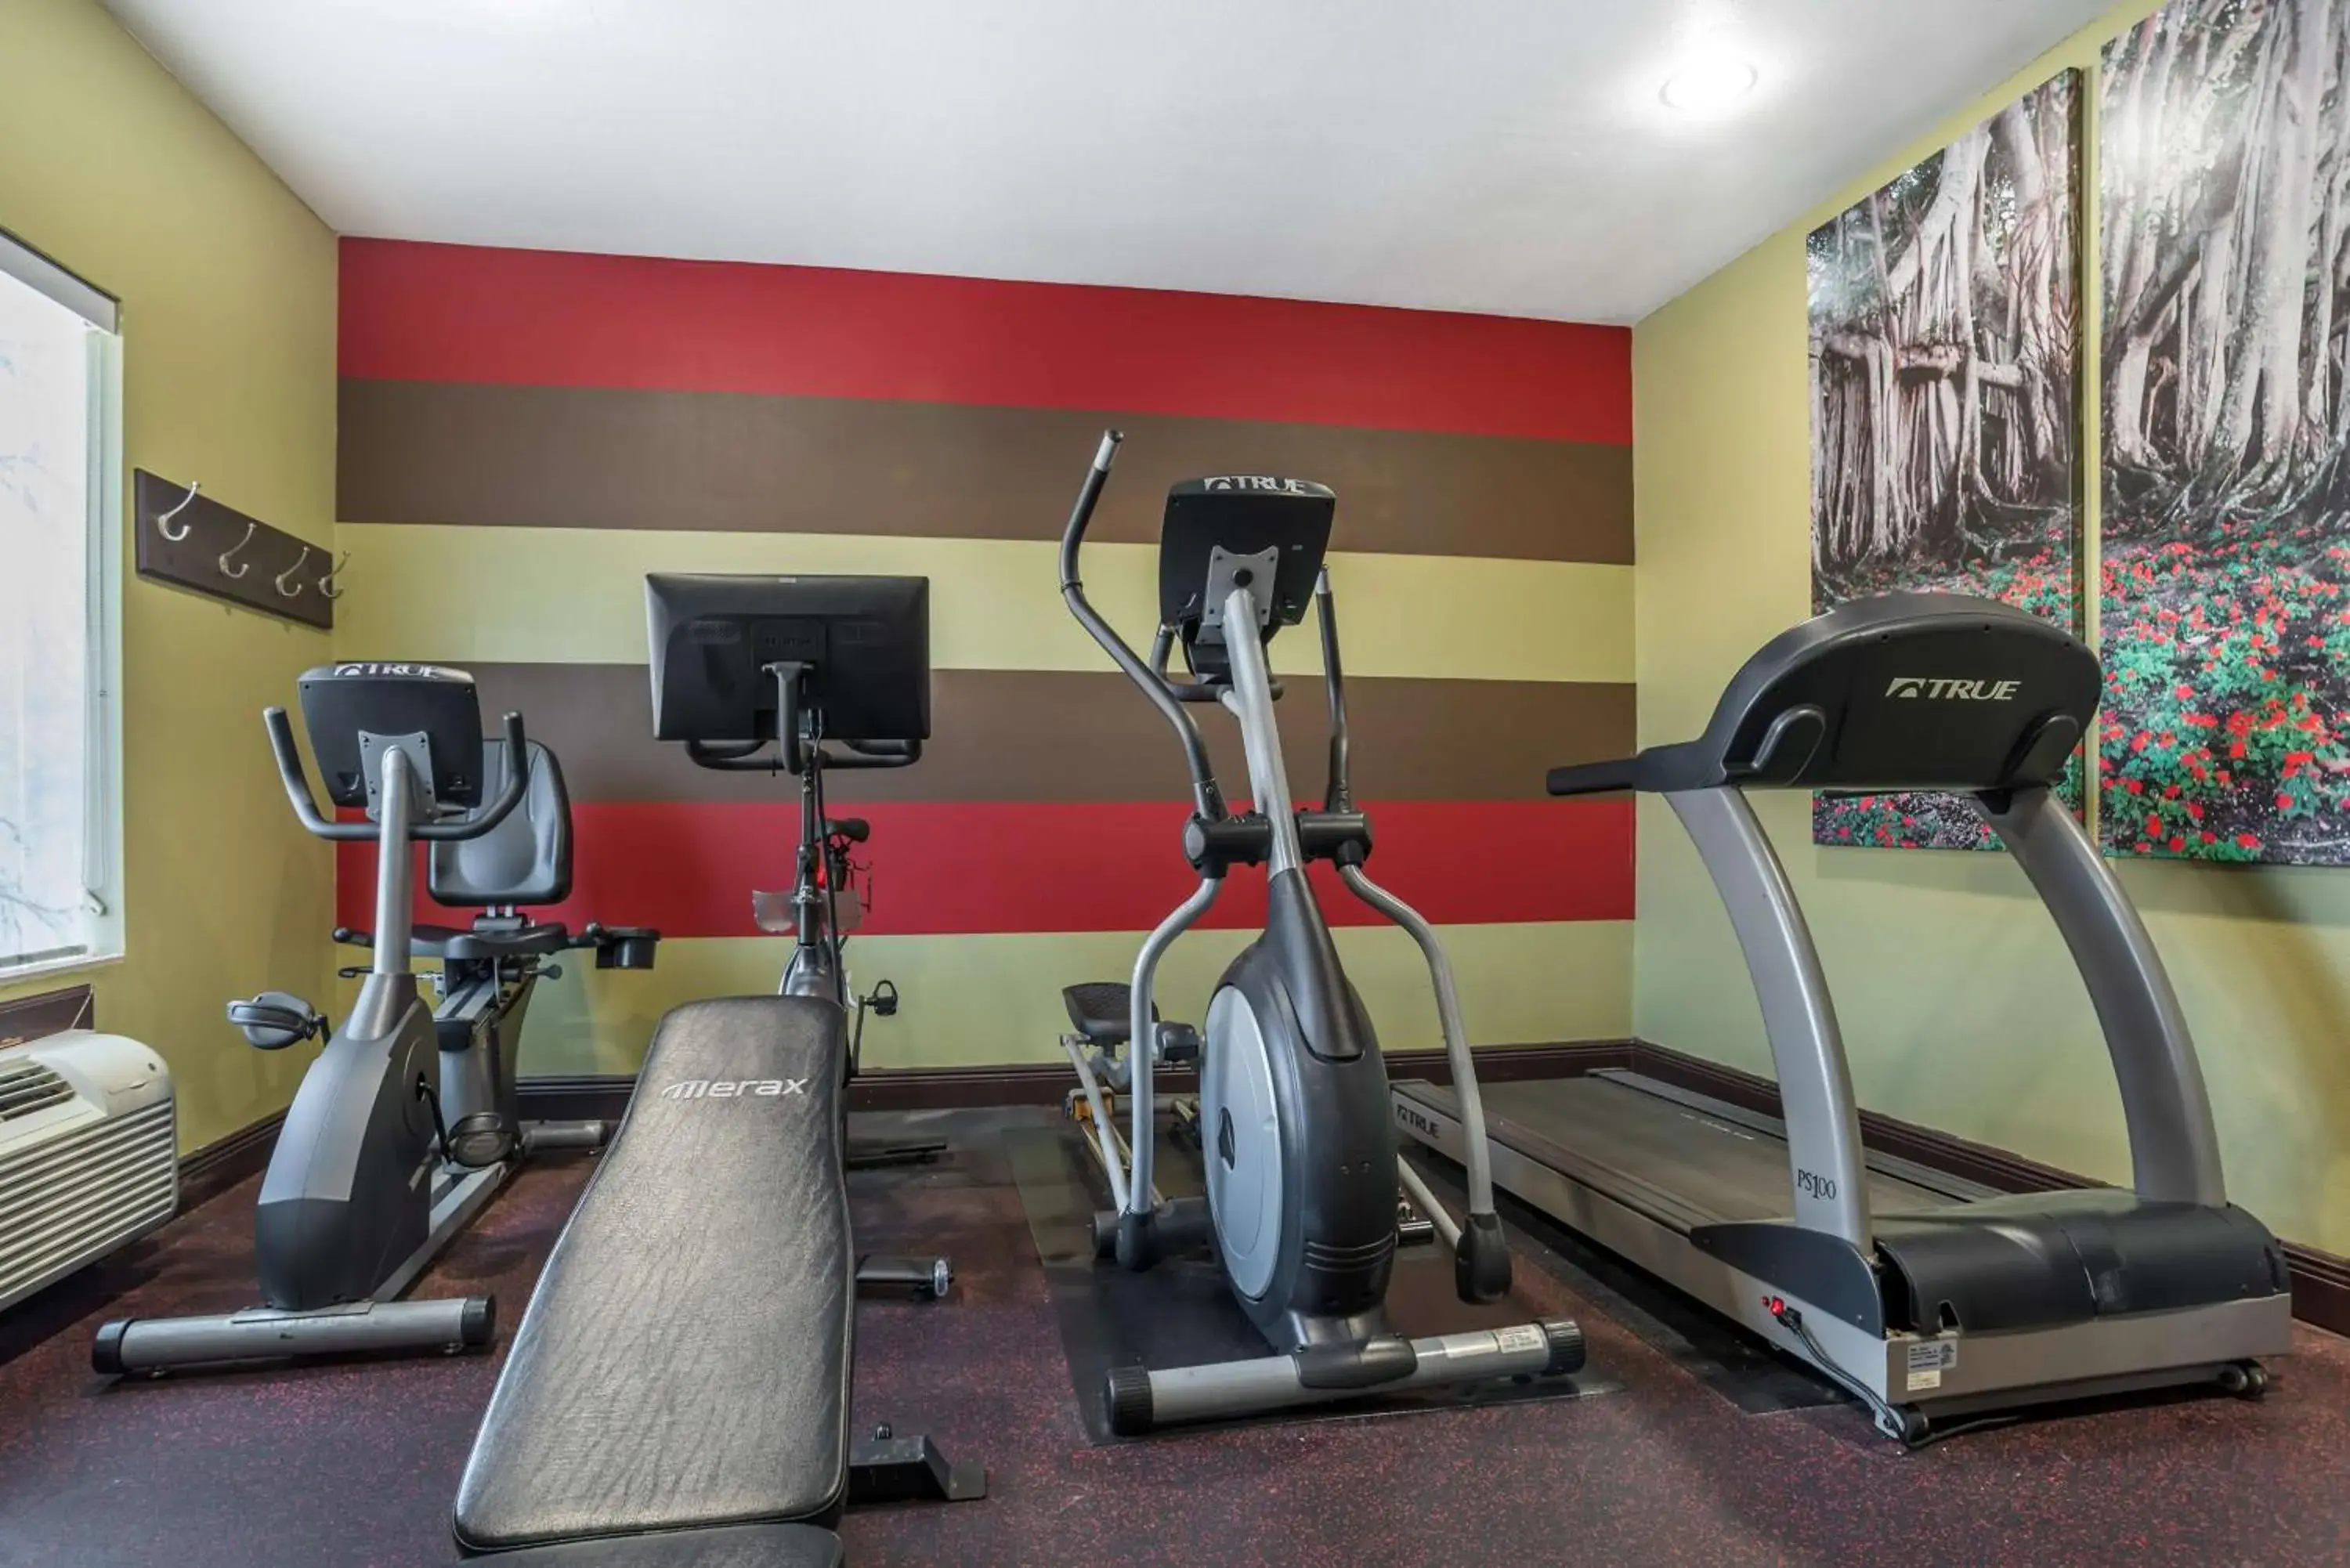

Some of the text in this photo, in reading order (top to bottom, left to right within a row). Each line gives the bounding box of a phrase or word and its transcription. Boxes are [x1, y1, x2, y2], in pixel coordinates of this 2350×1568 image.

[1231, 475, 1304, 493] TRUE
[367, 663, 439, 679] TRUE
[1928, 679, 2022, 699] TRUE
[1408, 1109, 1440, 1139] TRUE
[1798, 1168, 1837, 1200] PS100
